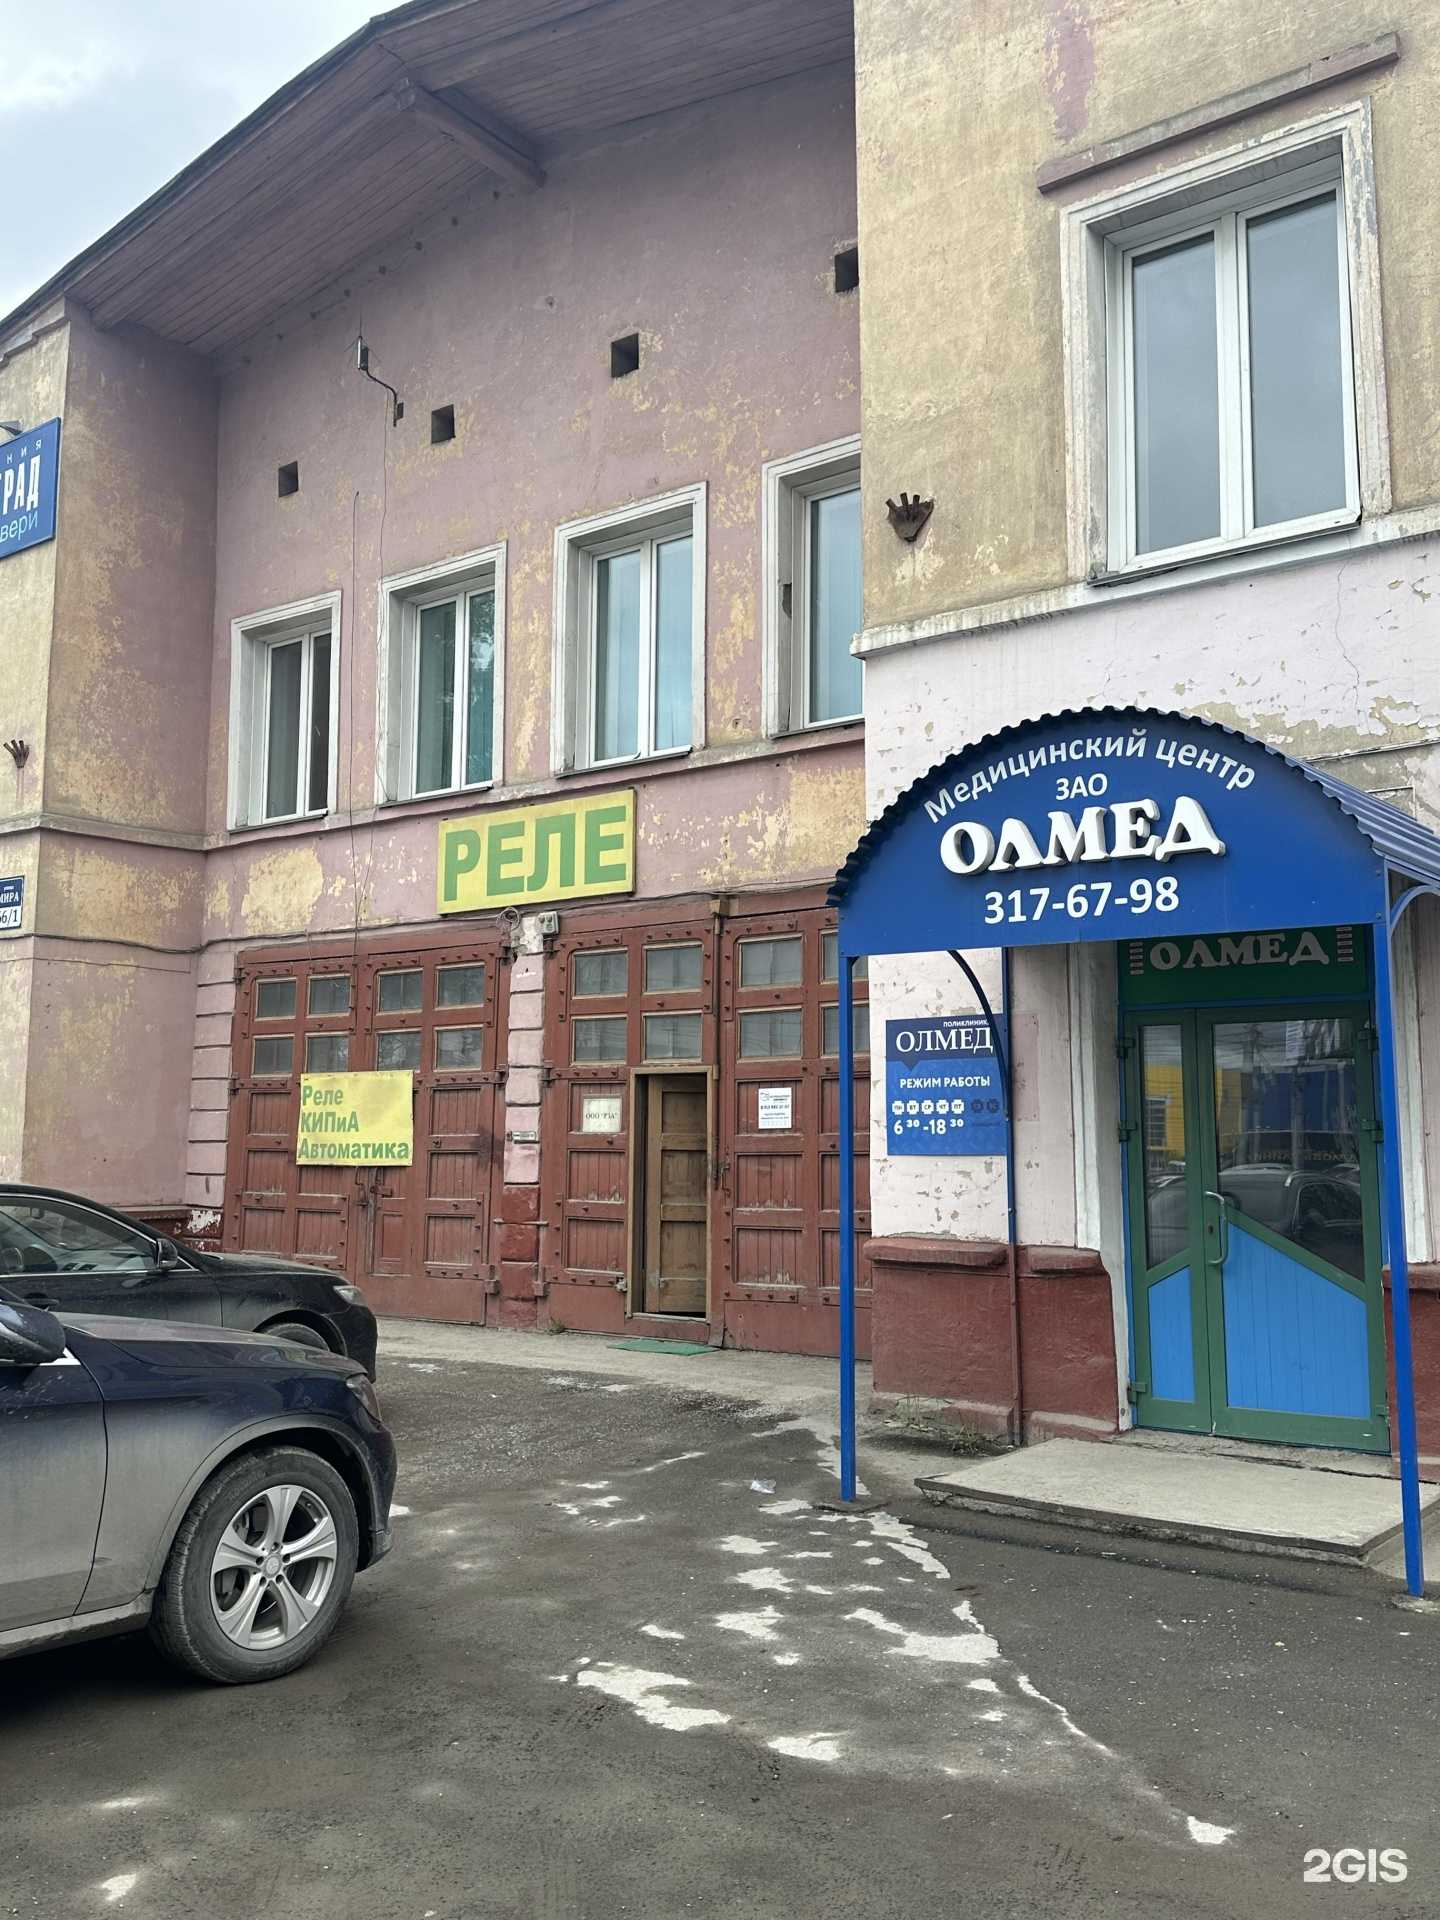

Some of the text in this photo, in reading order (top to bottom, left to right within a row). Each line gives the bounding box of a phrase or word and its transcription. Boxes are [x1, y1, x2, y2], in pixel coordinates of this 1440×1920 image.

[0, 455, 41, 515] РАД
[923, 728, 1255, 824] Медицинский центр
[1055, 773, 1108, 801] ЗАО
[940, 796, 1226, 875] ОЛМЕД
[444, 805, 627, 902] РЕЛЕ
[984, 876, 1179, 924] 317-67-98
[1150, 931, 1330, 970] ОЛМЕД
[896, 1027, 993, 1054] ОЛМЕД
[302, 1085, 343, 1106] Реле
[900, 1076, 991, 1089] РЕЖИМ РАБОТЫ
[300, 1111, 359, 1133] КИПиА
[298, 1138, 409, 1159] Автоматика
